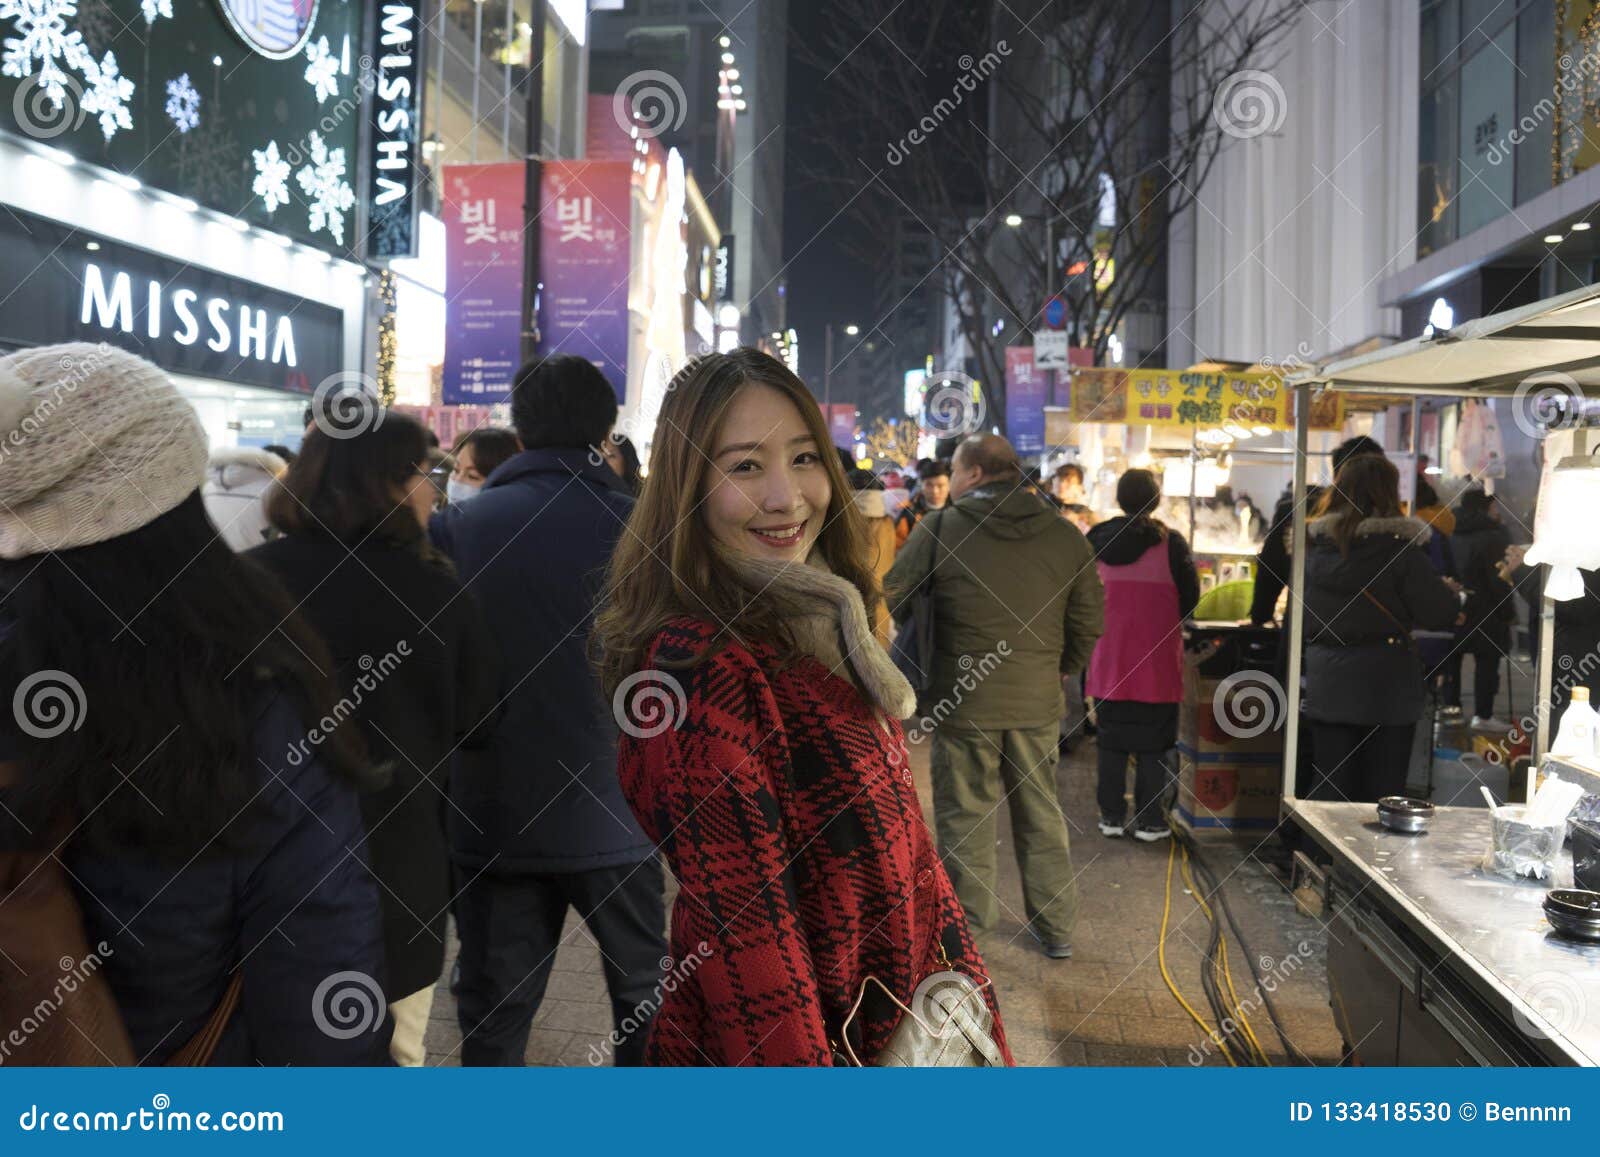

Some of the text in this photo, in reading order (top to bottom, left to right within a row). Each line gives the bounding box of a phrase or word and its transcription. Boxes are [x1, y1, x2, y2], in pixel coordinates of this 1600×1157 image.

[376, 4, 413, 205] MISSHA
[460, 198, 498, 244] 빛
[557, 197, 593, 242] 빛
[81, 263, 297, 367] MISSHA
[1180, 374, 1225, 400] 옛날
